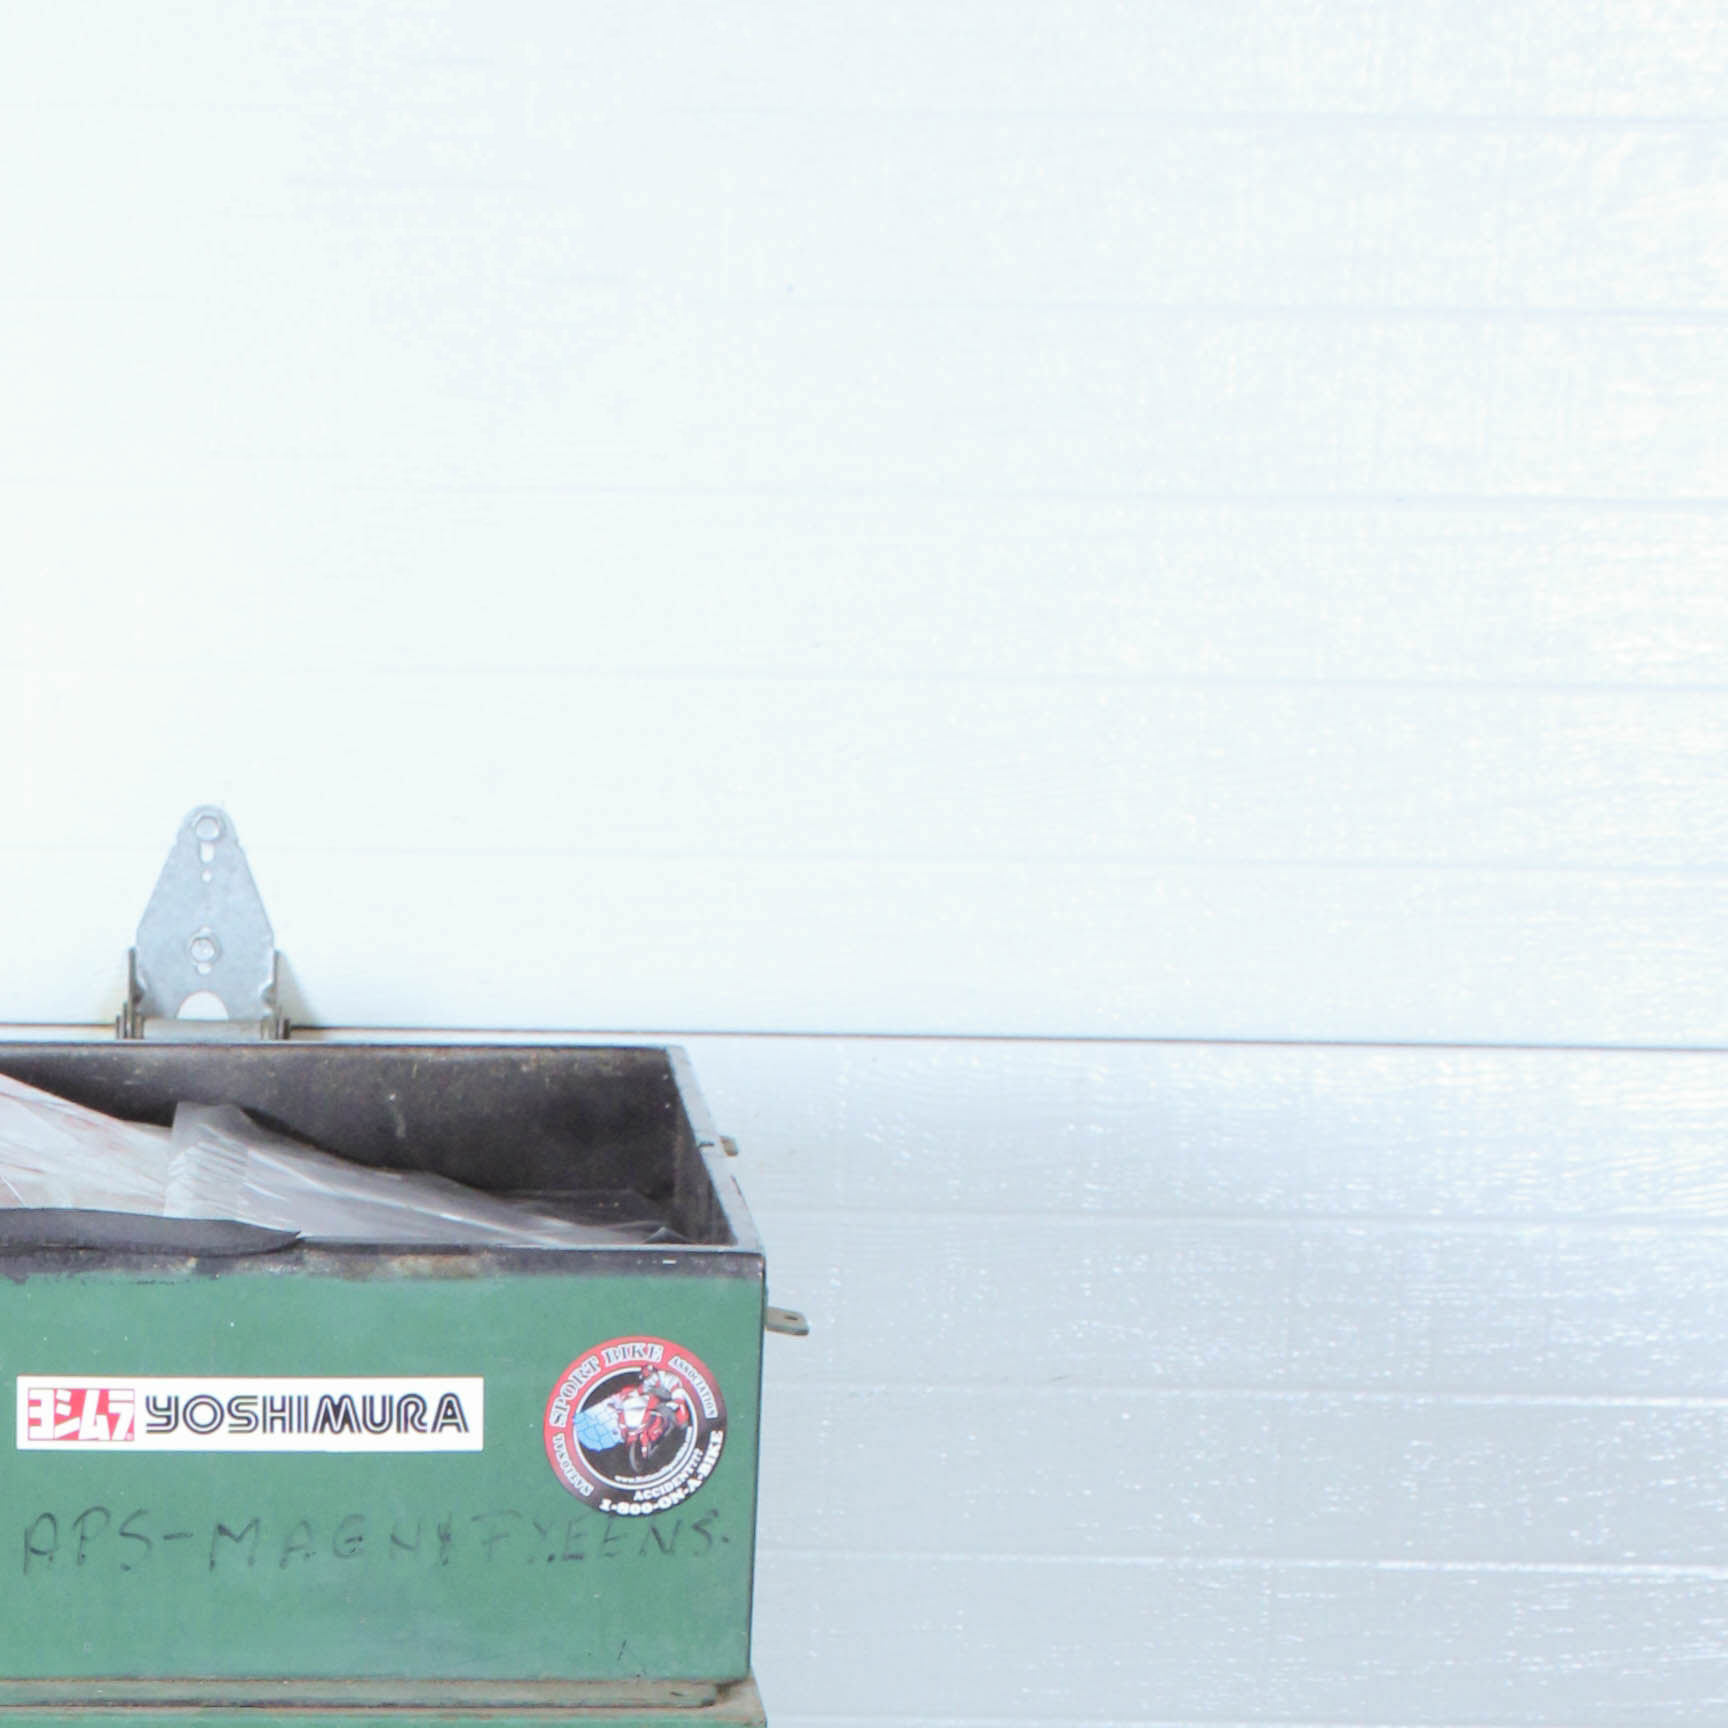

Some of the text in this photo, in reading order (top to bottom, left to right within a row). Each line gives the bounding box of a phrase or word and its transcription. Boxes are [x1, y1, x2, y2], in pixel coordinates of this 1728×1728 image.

[602, 1343, 664, 1367] BIKE
[28, 1388, 135, 1441] ヨシムラ
[144, 1393, 469, 1434] YOSHIMURA
[550, 1356, 600, 1428] SPORT
[669, 1356, 718, 1419] ASSOCIATION
[552, 1433, 594, 1497] NATIONAL
[600, 1430, 724, 1515] 1-800-ON-A-BIKE
